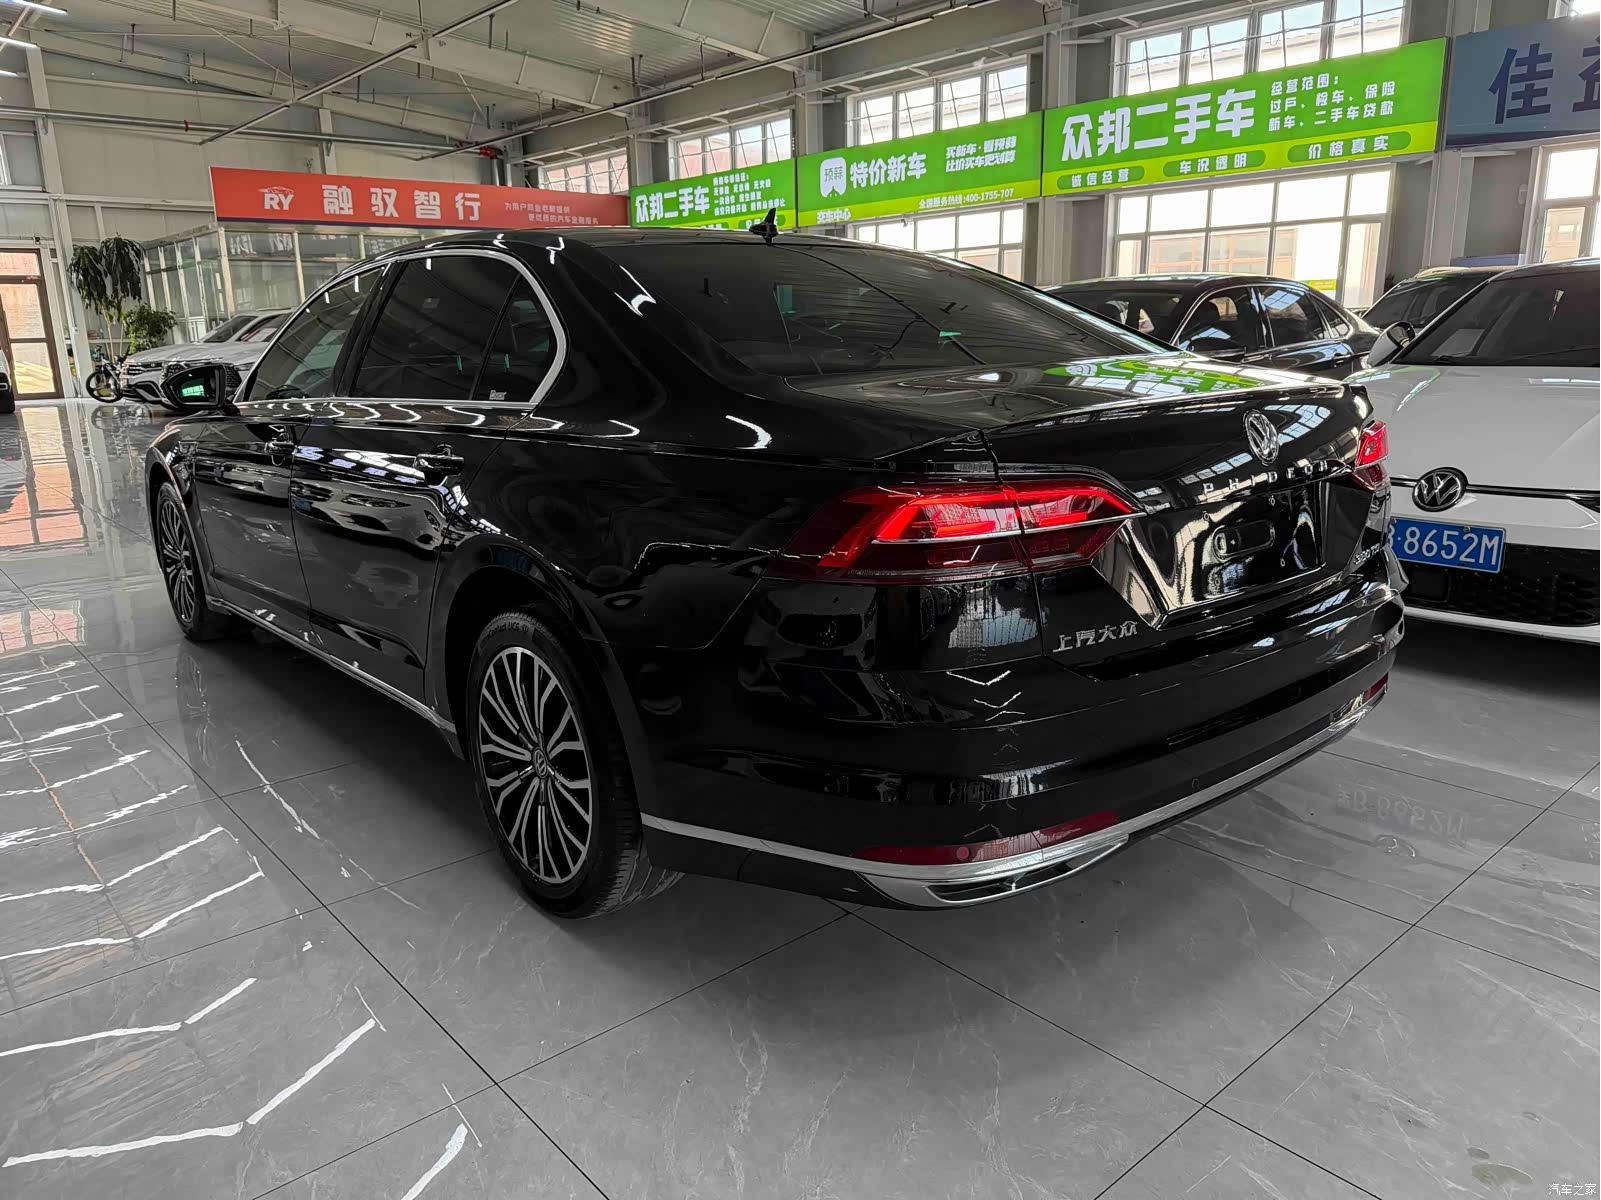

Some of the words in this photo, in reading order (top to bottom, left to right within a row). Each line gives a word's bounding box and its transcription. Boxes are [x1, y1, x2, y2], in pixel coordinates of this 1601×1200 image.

[1061, 88, 1256, 161] 众邦二手车
[1308, 134, 1389, 159] 价格真实
[850, 151, 927, 189] 特价新车
[1071, 166, 1130, 187] 诚信经营
[1179, 153, 1247, 174] 车况透明
[264, 193, 294, 211] RY
[322, 184, 482, 221] 融驭智行
[635, 185, 710, 223] 众邦二手车
[1053, 620, 1137, 653] 上汽大众
